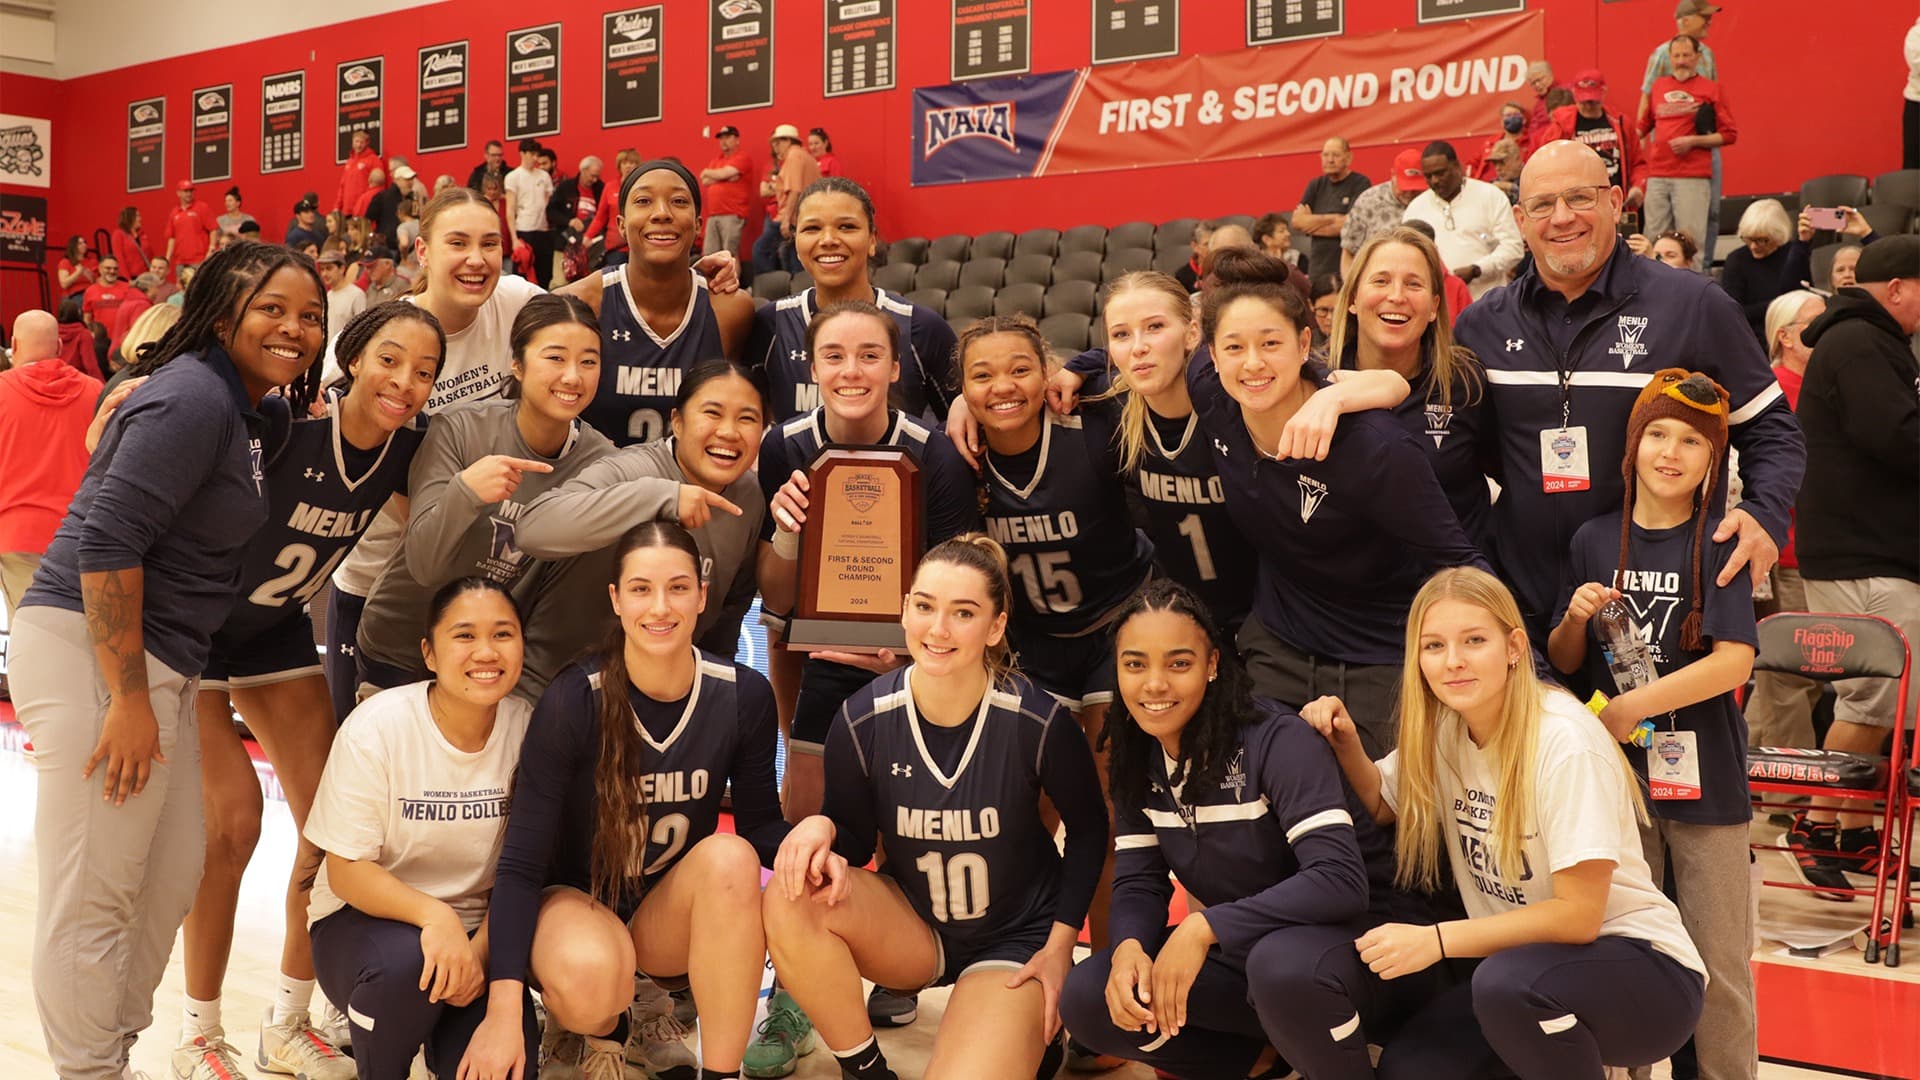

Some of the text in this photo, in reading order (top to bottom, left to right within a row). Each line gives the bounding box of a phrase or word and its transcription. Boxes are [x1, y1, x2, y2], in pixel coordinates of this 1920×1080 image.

[844, 4, 877, 16] VOLLEYBALL
[955, 7, 1028, 25] TOURNAMENT CHAMPIONS
[957, 0, 1025, 16] CASCADE CONFERENCE
[612, 13, 653, 35] Raiders
[726, 25, 758, 36] VOLLEYBALL
[829, 17, 891, 34] CASCADE CONFERENCE
[843, 29, 876, 41] CHAMPIONS
[611, 40, 654, 55] MEN'S WRESTLING
[265, 79, 301, 101] RAIDERS
[1099, 54, 1528, 135] FIRST & SECOND ROUND
[926, 101, 1016, 157] NAIA
[1618, 315, 1648, 326] MENLO
[434, 363, 489, 393] WOMEN'S
[427, 371, 505, 409] BASKETBALL
[845, 484, 882, 492] BASKETBALL
[1140, 469, 1226, 504] MENLO
[1299, 474, 1327, 491] MENLO
[1545, 480, 1565, 490] 2024
[986, 511, 1079, 544] MENLO
[1177, 513, 1217, 581] 1
[828, 555, 894, 565] FIRST & SECOND
[838, 573, 882, 582] CHAMPION
[846, 565, 875, 573] ROUND
[1010, 551, 1083, 614] 15
[850, 598, 868, 606] 2024
[1794, 628, 1855, 648] Flagship
[1811, 647, 1835, 664] Inn
[1749, 761, 1840, 782] AIDERS
[423, 787, 505, 798] WOMEN'S BASKETBALL
[637, 769, 709, 804] ENLO
[1652, 787, 1673, 797] 2024
[401, 802, 457, 822] MENLO
[897, 805, 1000, 842] MENLO
[915, 851, 991, 923] 10
